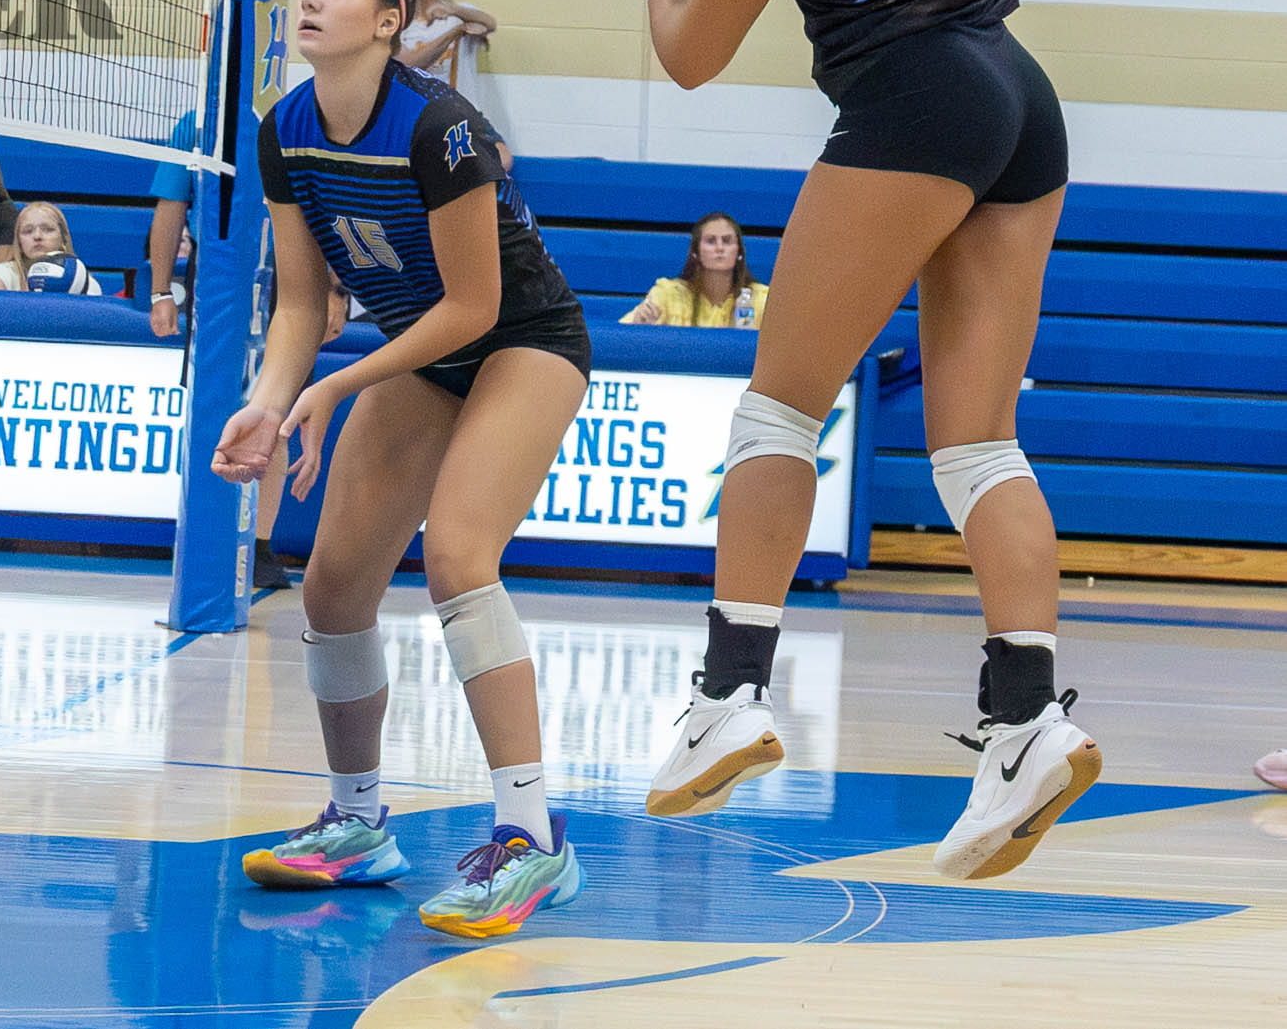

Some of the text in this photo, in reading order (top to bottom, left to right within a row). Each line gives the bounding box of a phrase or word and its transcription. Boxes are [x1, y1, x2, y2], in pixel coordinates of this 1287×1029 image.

[330, 215, 404, 273] 15
[149, 386, 184, 417] TO
[586, 381, 640, 411] THE
[526, 473, 688, 528] LLIES
